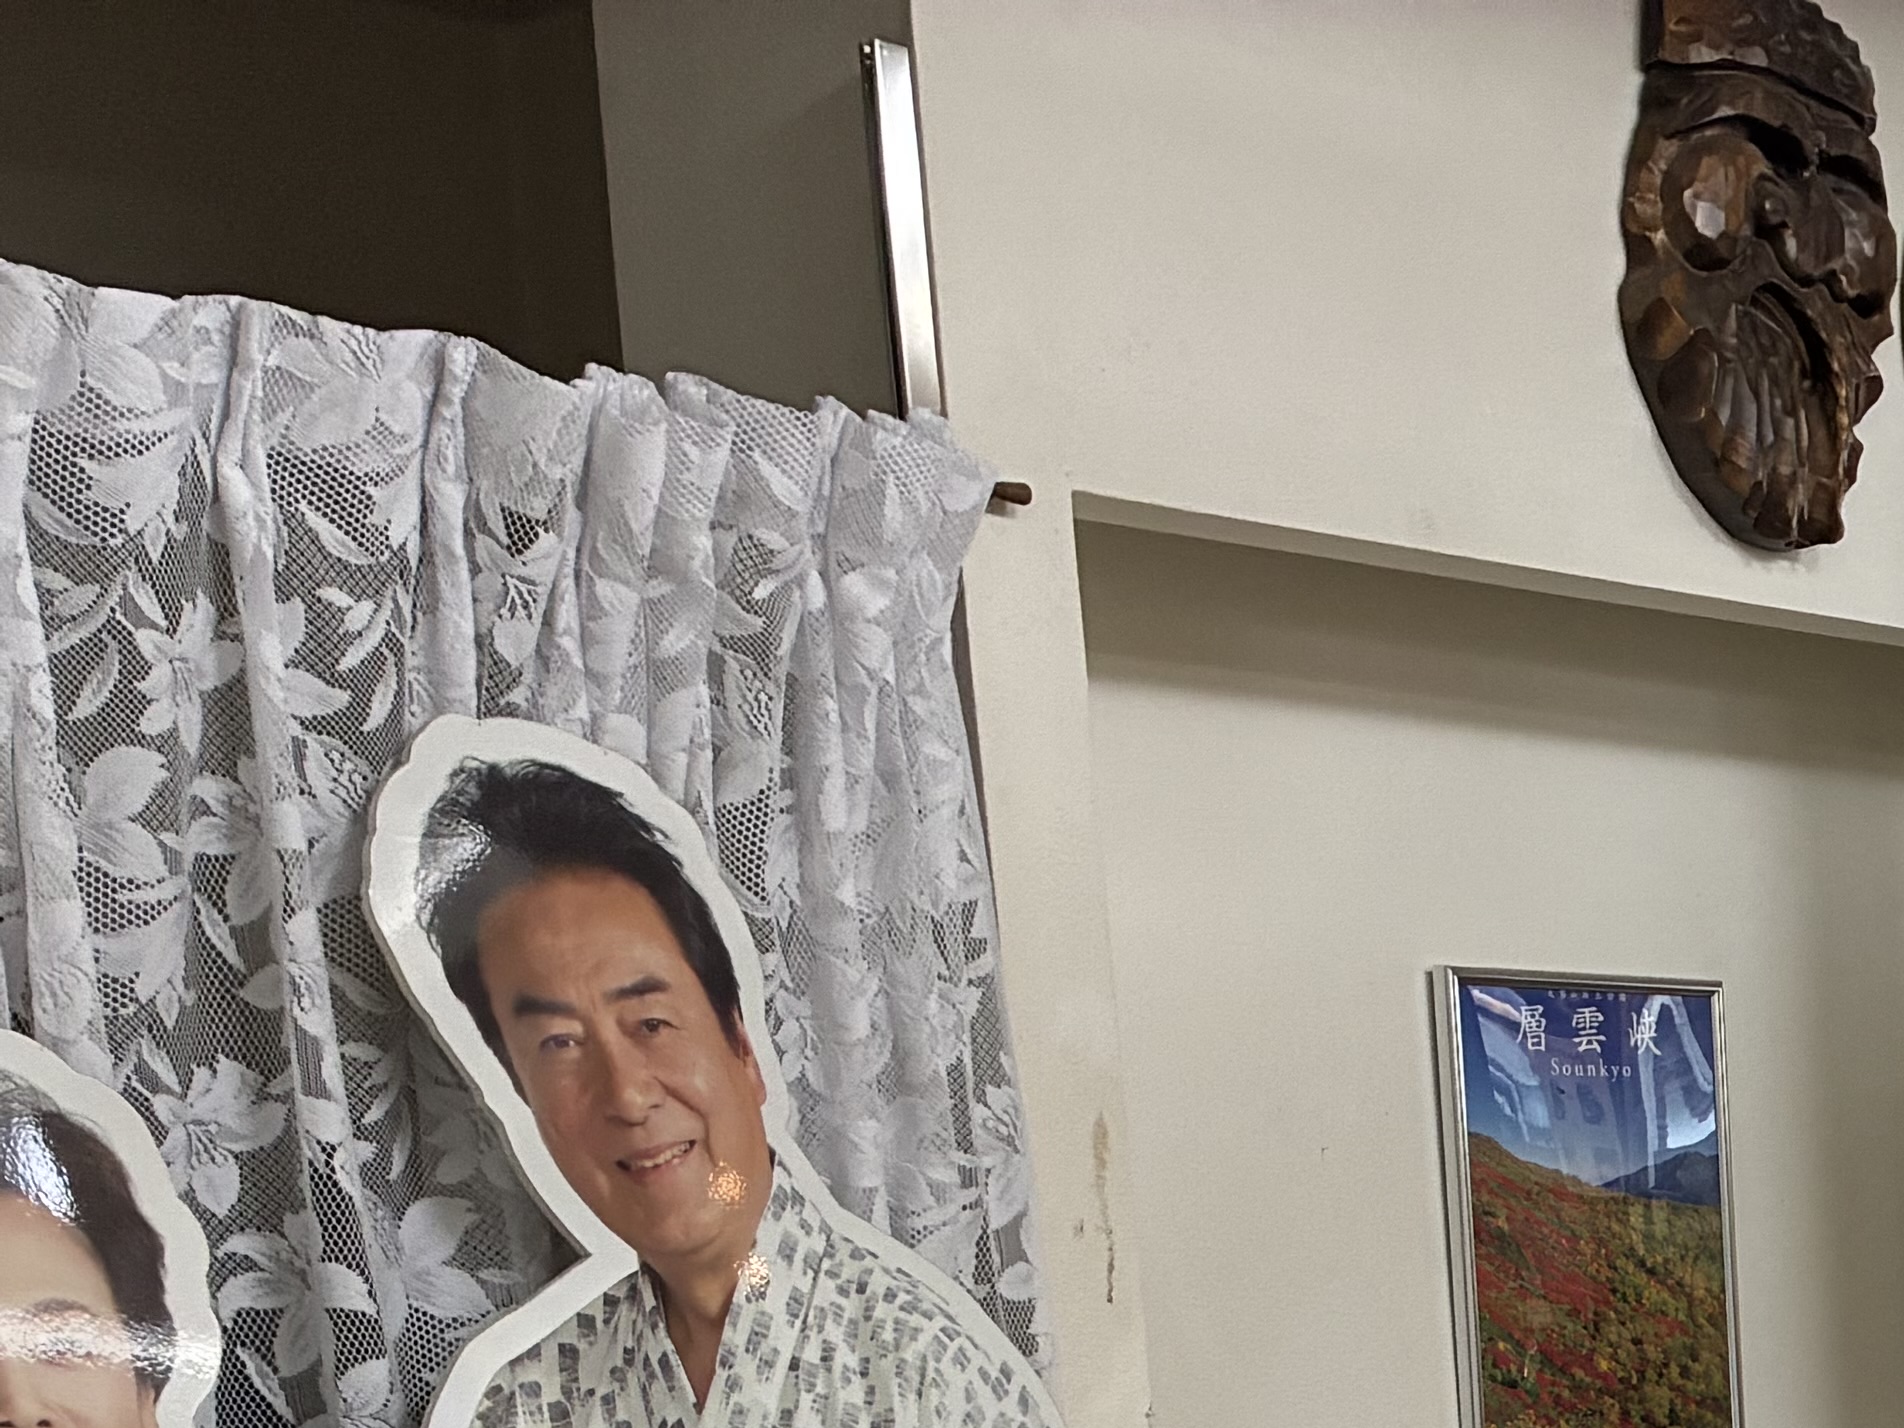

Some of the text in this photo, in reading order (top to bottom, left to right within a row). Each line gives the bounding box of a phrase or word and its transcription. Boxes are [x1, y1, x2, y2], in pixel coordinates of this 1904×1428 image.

[1516, 1004, 1662, 1055] 層雲峡
[1551, 1057, 1632, 1081] Sounkyo
